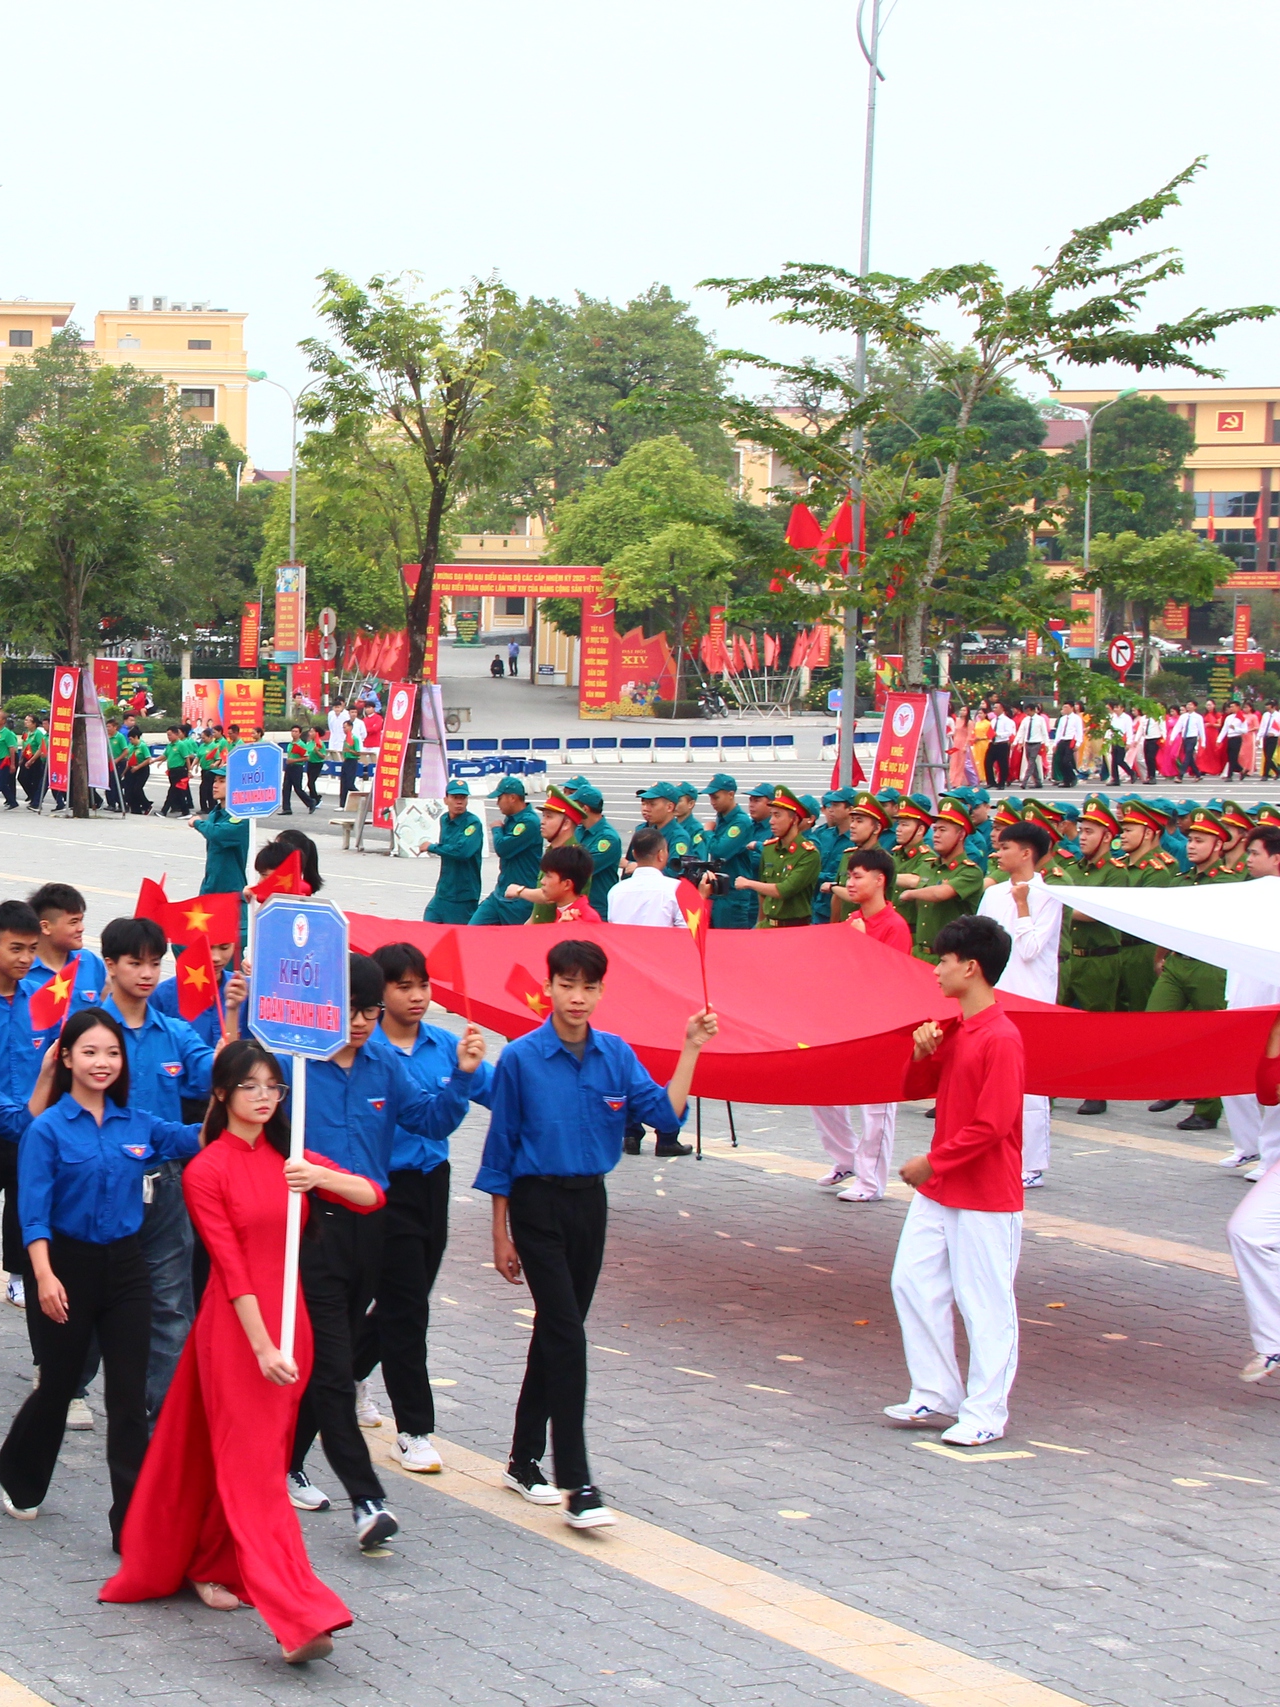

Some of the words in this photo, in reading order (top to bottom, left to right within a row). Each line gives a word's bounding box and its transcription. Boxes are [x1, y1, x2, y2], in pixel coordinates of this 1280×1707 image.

[621, 656, 648, 664] XIV
[241, 766, 265, 785] KHỐI
[279, 952, 319, 988] KHỐI
[258, 992, 284, 1024] ĐOÀN
[285, 999, 315, 1029] THANH
[315, 1000, 340, 1032] NIÊN
